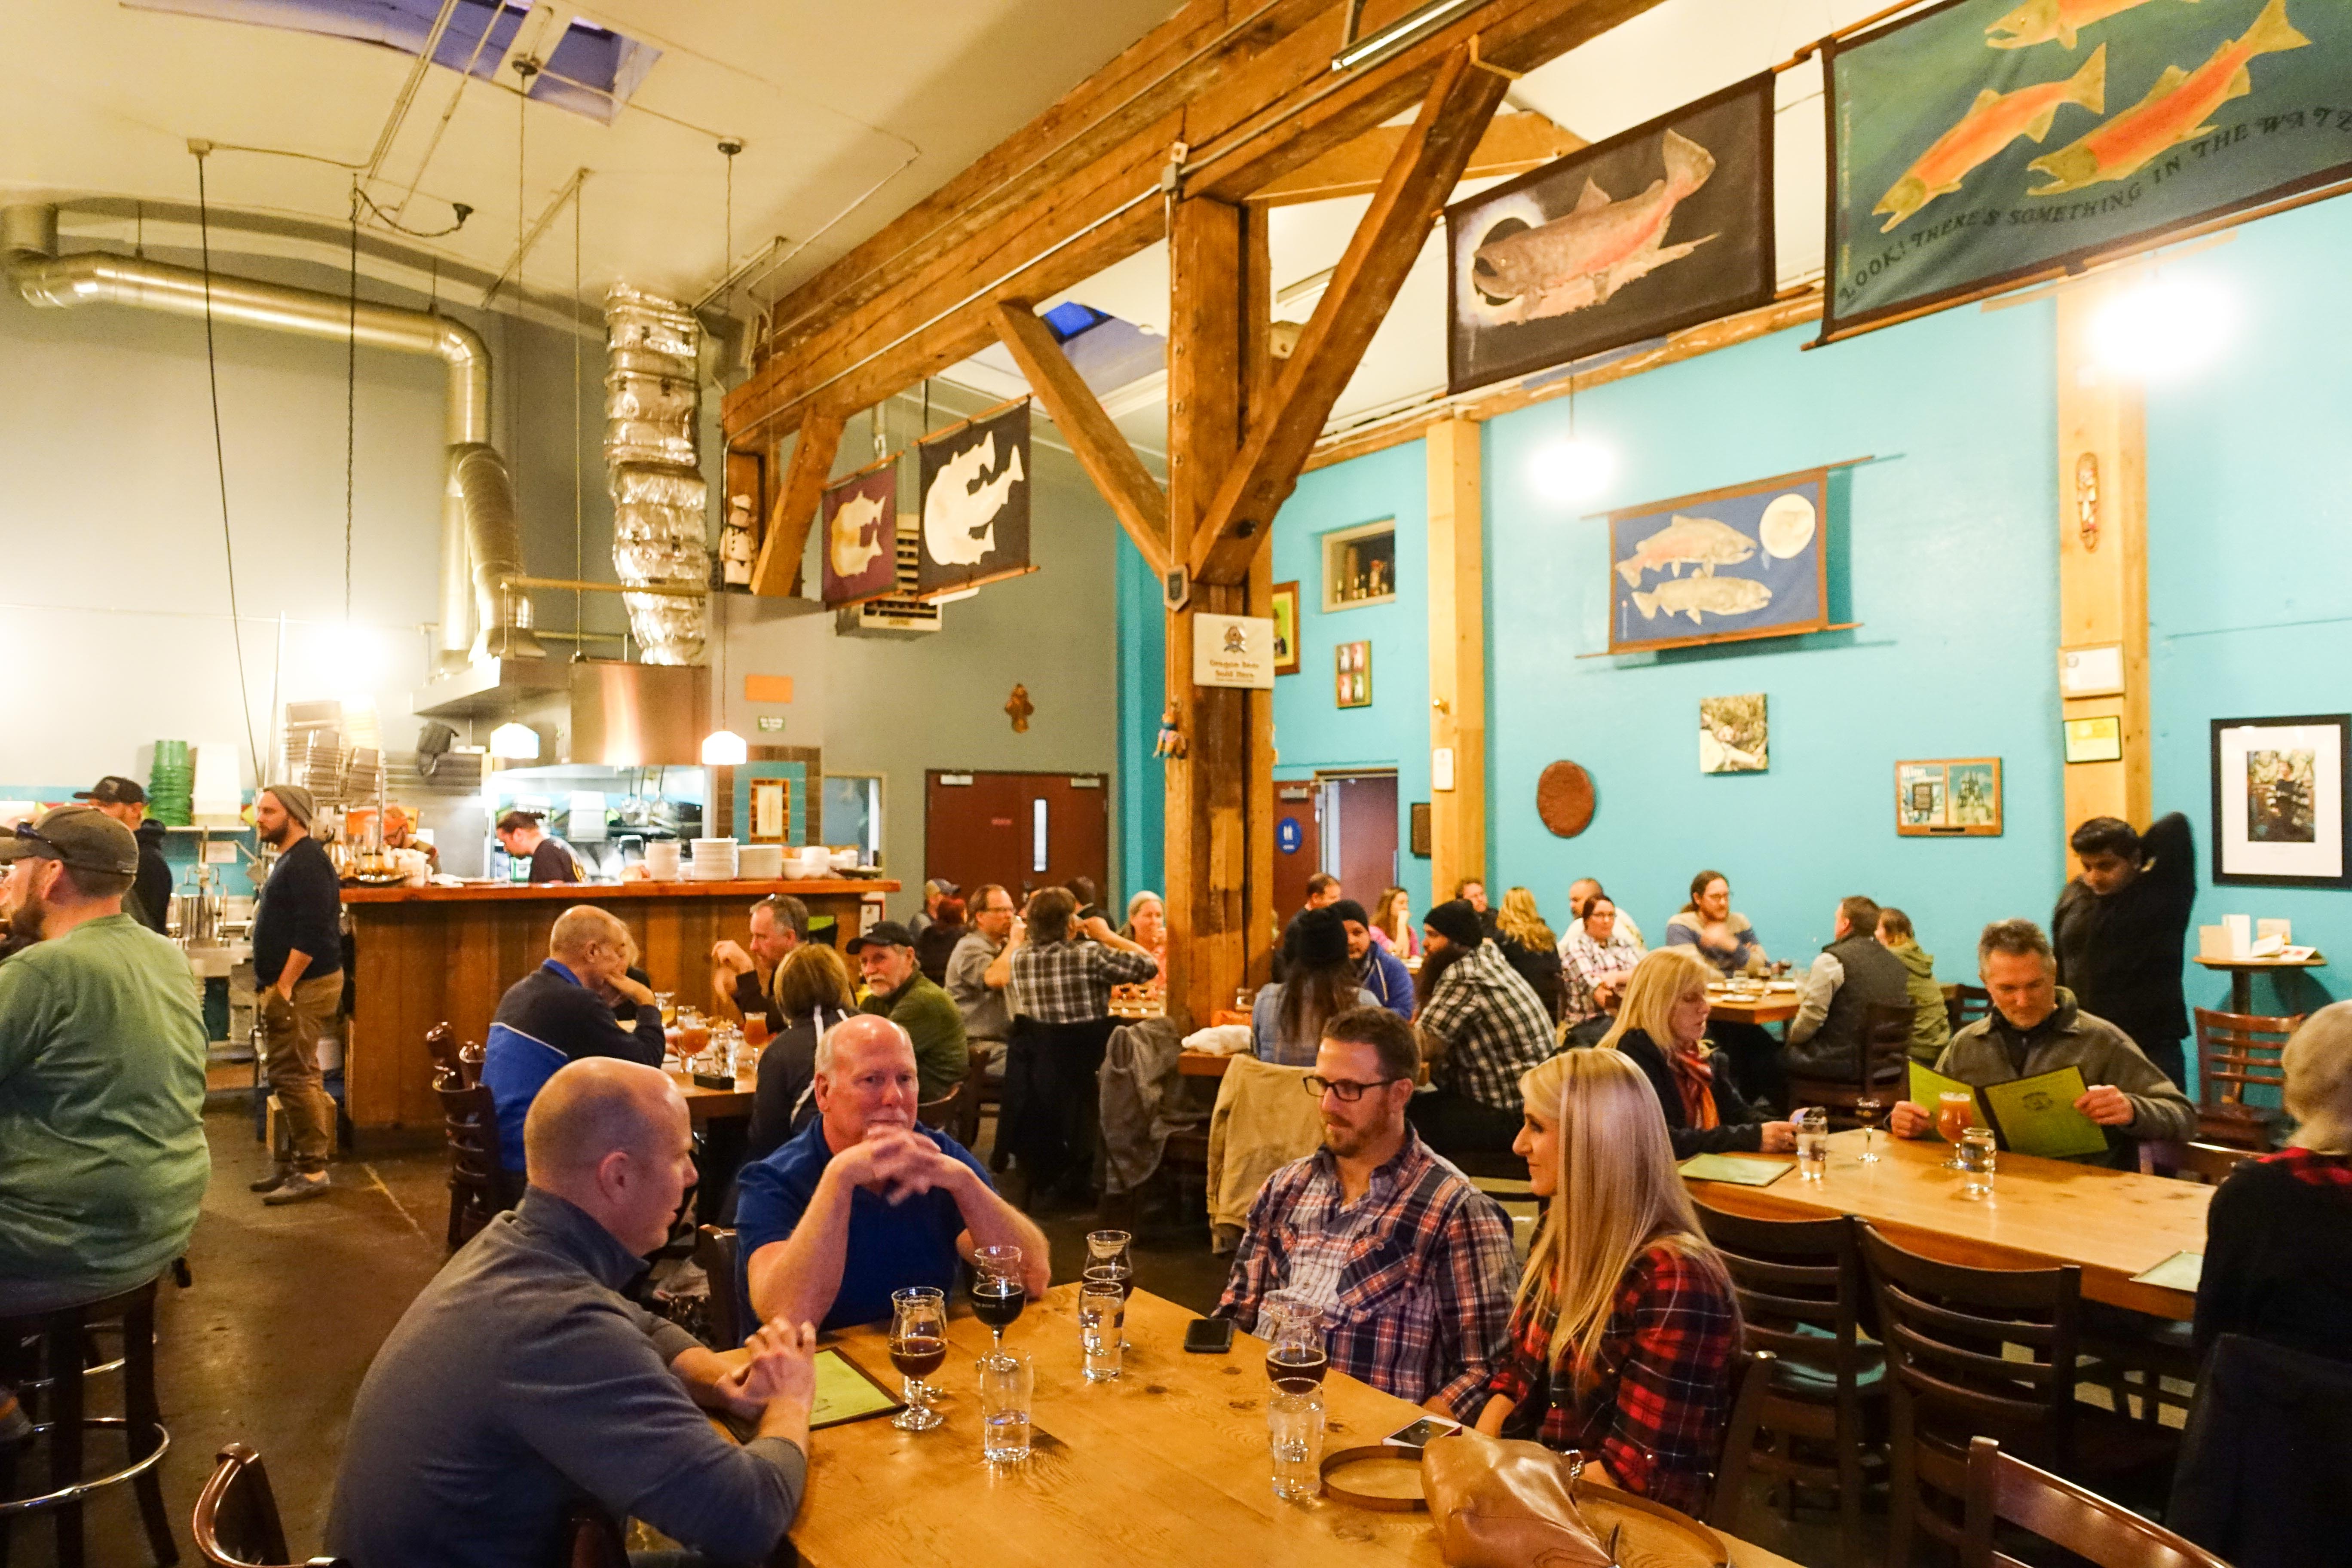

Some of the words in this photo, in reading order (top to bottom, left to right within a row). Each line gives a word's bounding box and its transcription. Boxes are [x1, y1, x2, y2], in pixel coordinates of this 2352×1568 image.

[1839, 240, 1907, 300] LOOK!
[2008, 181, 2142, 225] SOMETHING
[2153, 155, 2181, 184] IN
[2190, 123, 2249, 159] THE
